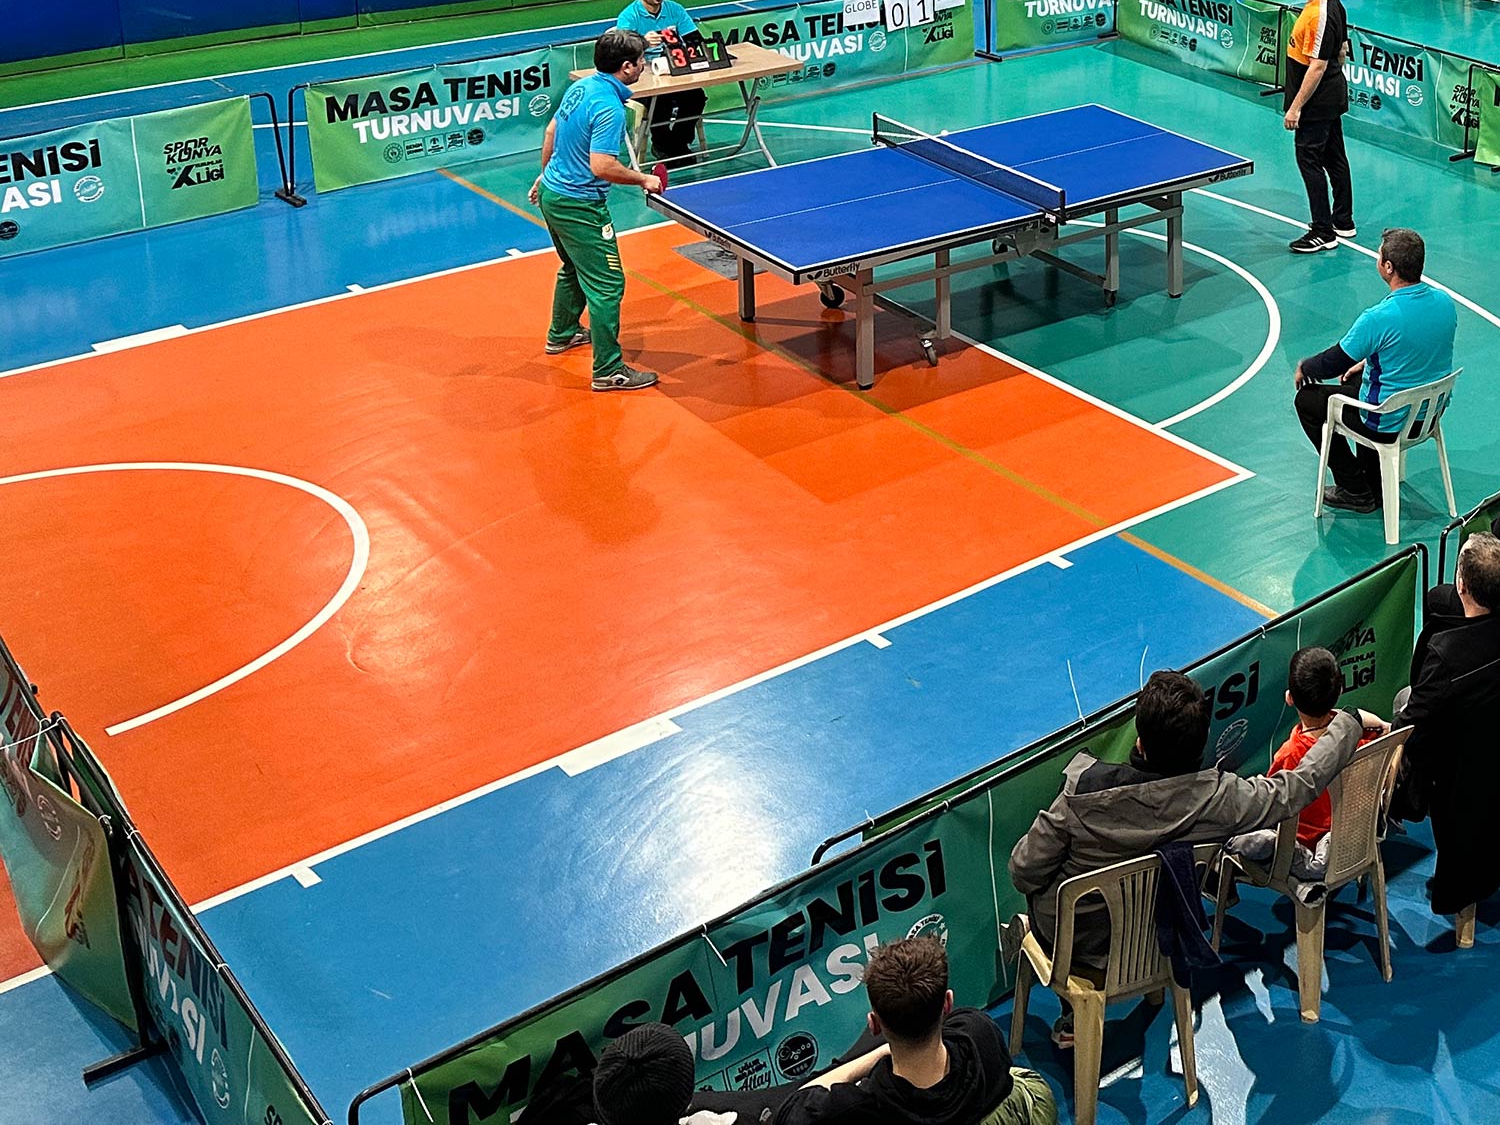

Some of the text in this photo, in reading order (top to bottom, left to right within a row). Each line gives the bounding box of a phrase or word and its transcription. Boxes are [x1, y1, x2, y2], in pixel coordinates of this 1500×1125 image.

[891, 2, 902, 28] 0
[1138, 0, 1219, 41] TURNUVASI
[711, 20, 800, 48] MASA
[671, 48, 687, 68] 3
[688, 46, 697, 58] 2
[706, 42, 720, 61] 7
[1360, 41, 1424, 82] TENİSİ
[325, 62, 551, 124] MASA TENİSİ
[353, 96, 520, 144] TURNUVASI
[163, 137, 209, 154] SPOR
[166, 145, 222, 165] KONYA
[196, 164, 225, 186] LİGİ
[823, 261, 860, 278] Butterfly
[1342, 659, 1376, 695] LİGİ
[721, 839, 947, 995] TENİSİ
[738, 1070, 771, 1091] Altay
